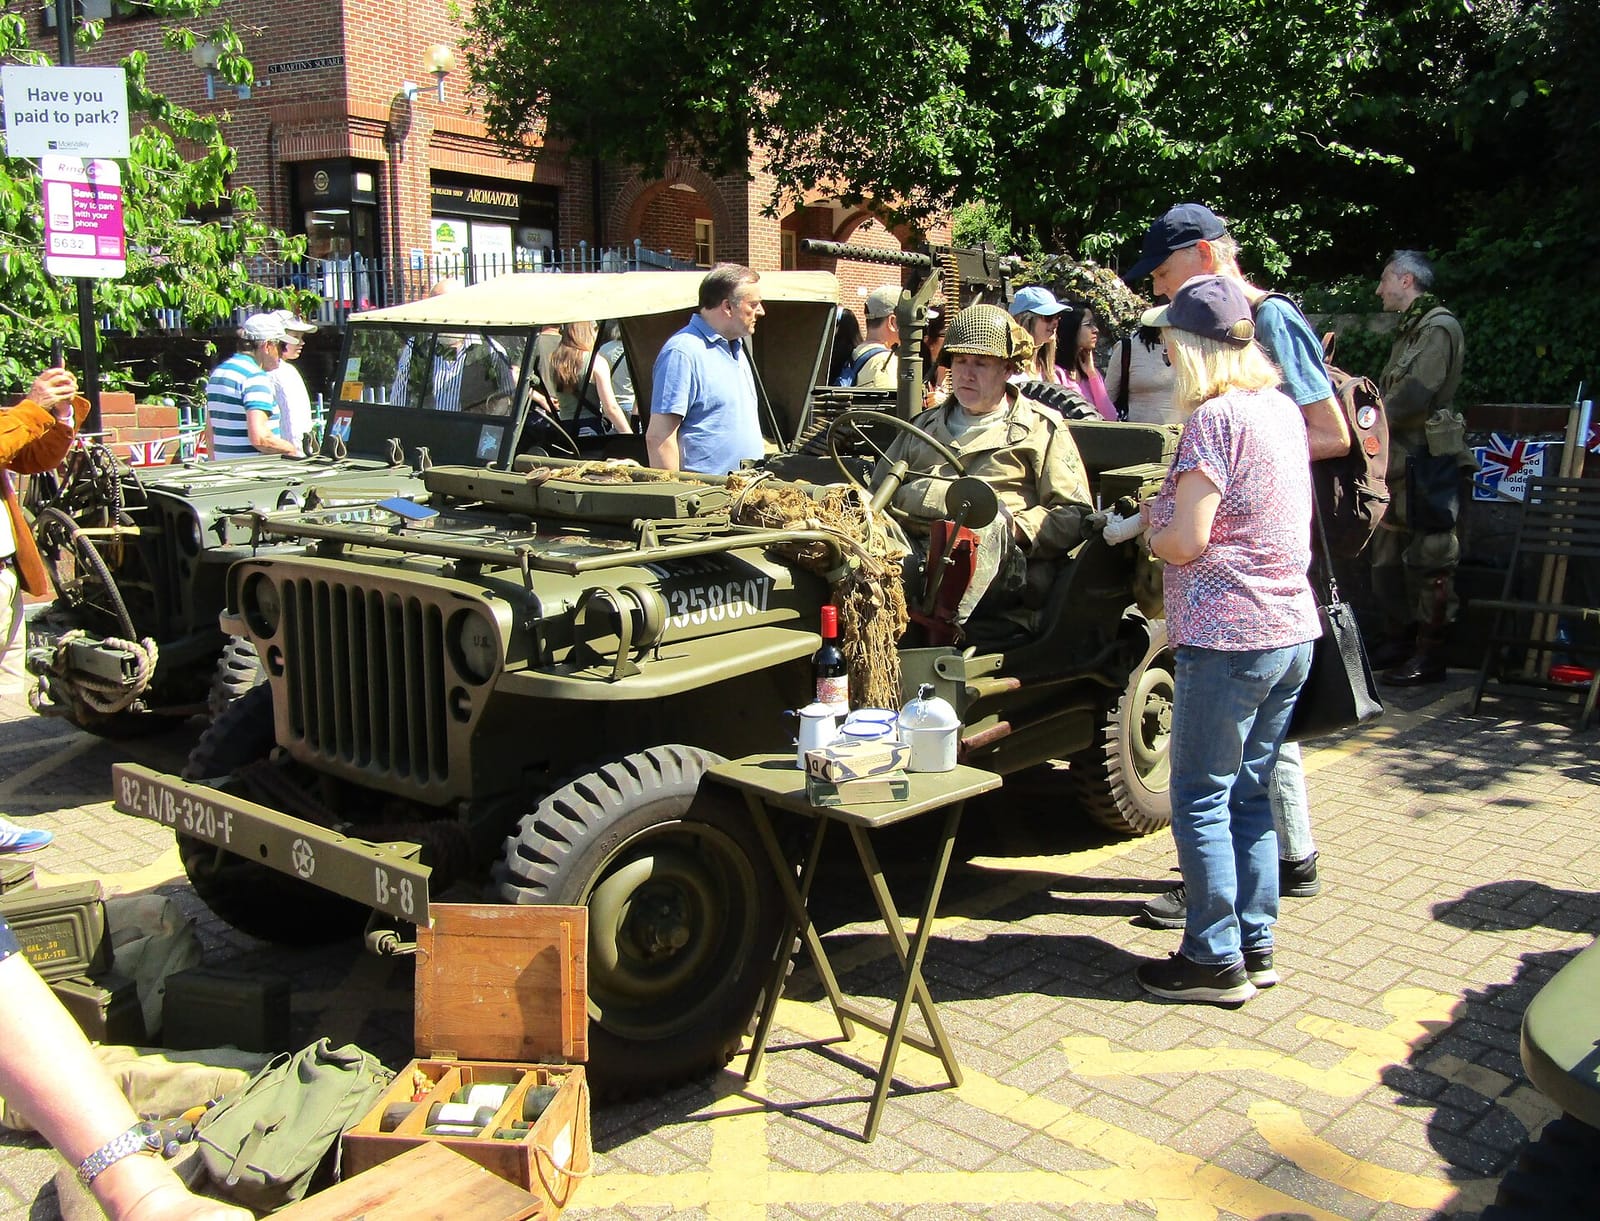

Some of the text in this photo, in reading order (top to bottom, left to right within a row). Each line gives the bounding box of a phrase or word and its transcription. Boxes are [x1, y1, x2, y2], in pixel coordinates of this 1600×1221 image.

[28, 88, 103, 106] Have you
[14, 109, 119, 127] paid to park?
[73, 188, 118, 201] Save time
[466, 188, 519, 207] AROMANTICA
[74, 200, 88, 209] Pay
[99, 203, 115, 211] park
[75, 210, 108, 220] with your
[75, 219, 98, 228] phone
[54, 238, 84, 249] 5632
[660, 577, 769, 630] 358607
[120, 775, 233, 844] 82-A/B-320-F
[375, 866, 414, 915] B-8
